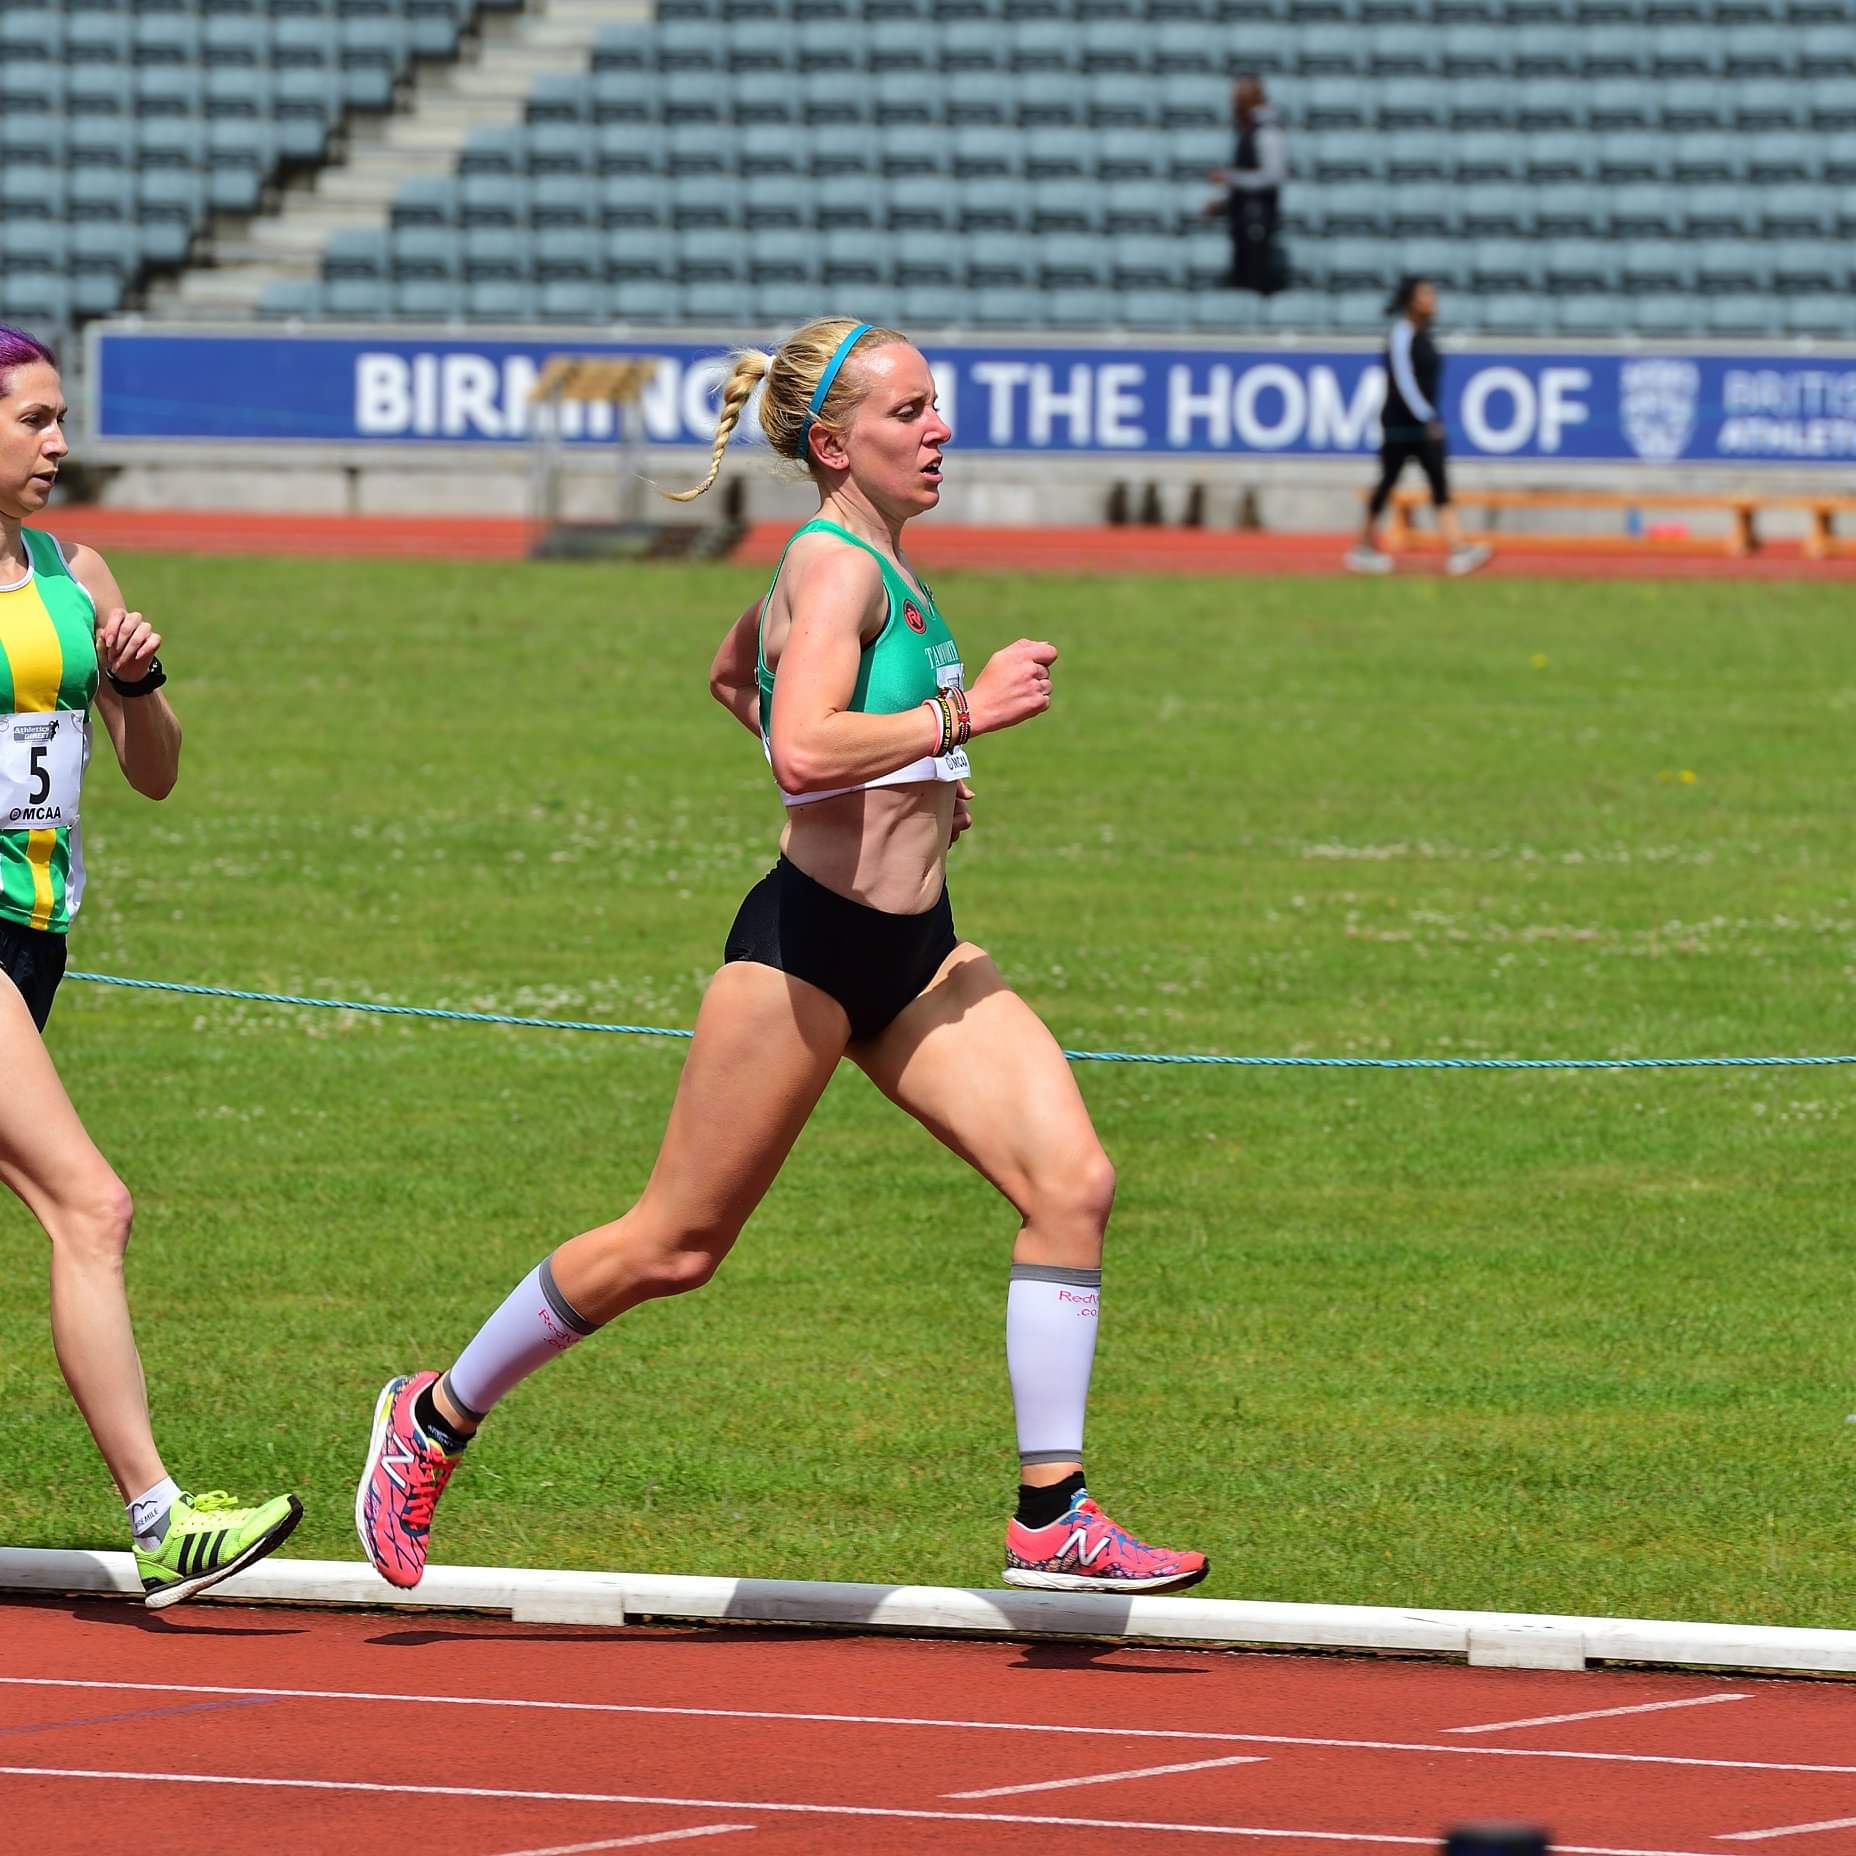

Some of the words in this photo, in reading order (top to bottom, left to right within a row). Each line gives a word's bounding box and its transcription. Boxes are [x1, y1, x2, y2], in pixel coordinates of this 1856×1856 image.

[971, 361, 1147, 447] THE
[1167, 363, 1389, 450] HOM
[1460, 365, 1592, 454] OF
[29, 746, 50, 805] 5
